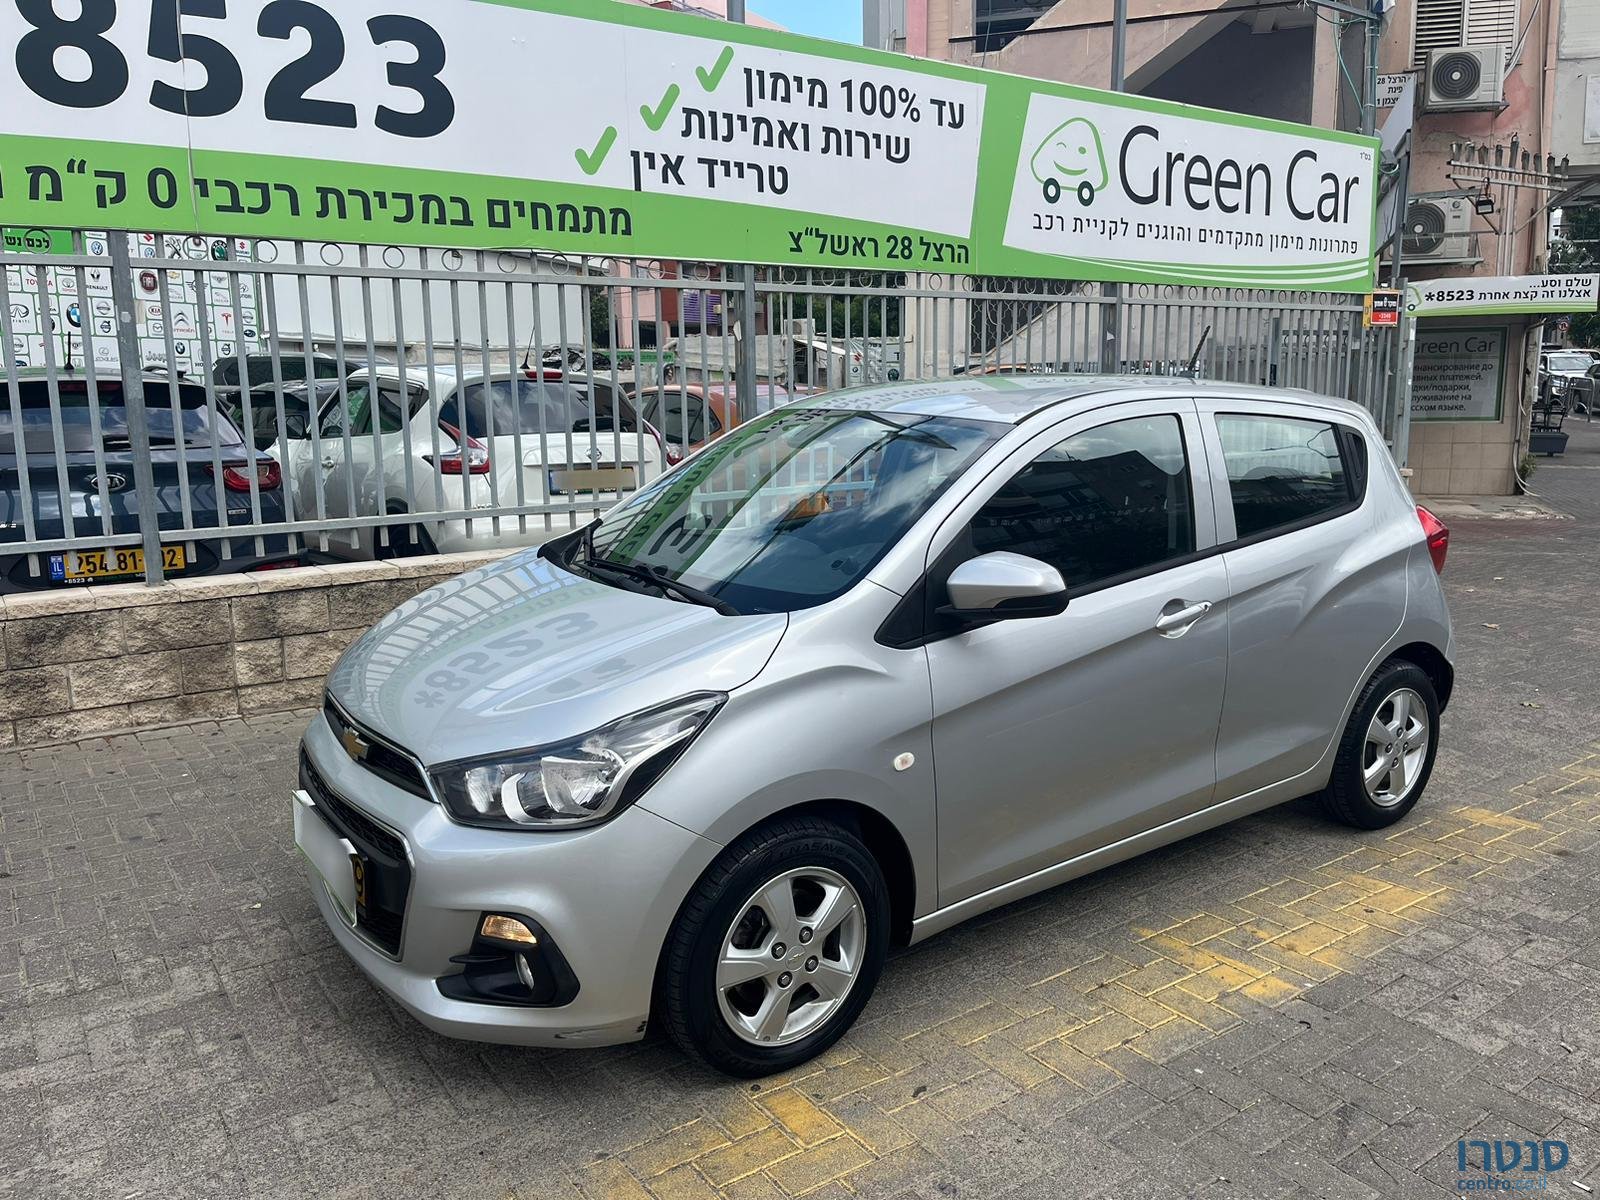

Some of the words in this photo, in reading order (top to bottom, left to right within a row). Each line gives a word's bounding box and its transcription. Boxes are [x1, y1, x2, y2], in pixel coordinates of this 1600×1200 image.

[15, 0, 456, 138] 8523
[743, 67, 828, 109] מימון
[841, 79, 921, 123] 100%
[930, 98, 965, 129] עד
[681, 107, 811, 152] ואמינות
[821, 127, 911, 163] שירות
[630, 149, 685, 191] אין
[697, 156, 789, 195] טרייד
[1118, 125, 1272, 216] Green
[1286, 149, 1360, 224] Car
[193, 176, 301, 216] רכבי
[315, 186, 474, 228] במכירת
[487, 198, 633, 236] מתמחים
[1033, 212, 1065, 231] רכב
[1072, 217, 1129, 240] לקניית
[1137, 223, 1191, 243] והוגנים
[1199, 228, 1264, 247] מתקדמים
[1269, 235, 1304, 252] מימון
[1309, 237, 1358, 254] פתרונות
[886, 234, 913, 259] 28
[919, 236, 969, 264] הרצל
[1542, 289, 1555, 299] זה
[1558, 288, 1591, 298] אצלנו
[1565, 277, 1592, 287] שלם
[1478, 291, 1509, 300] אחרת
[1513, 289, 1538, 301] קצת
[1464, 336, 1496, 353] Car
[1481, 363, 1493, 371] до
